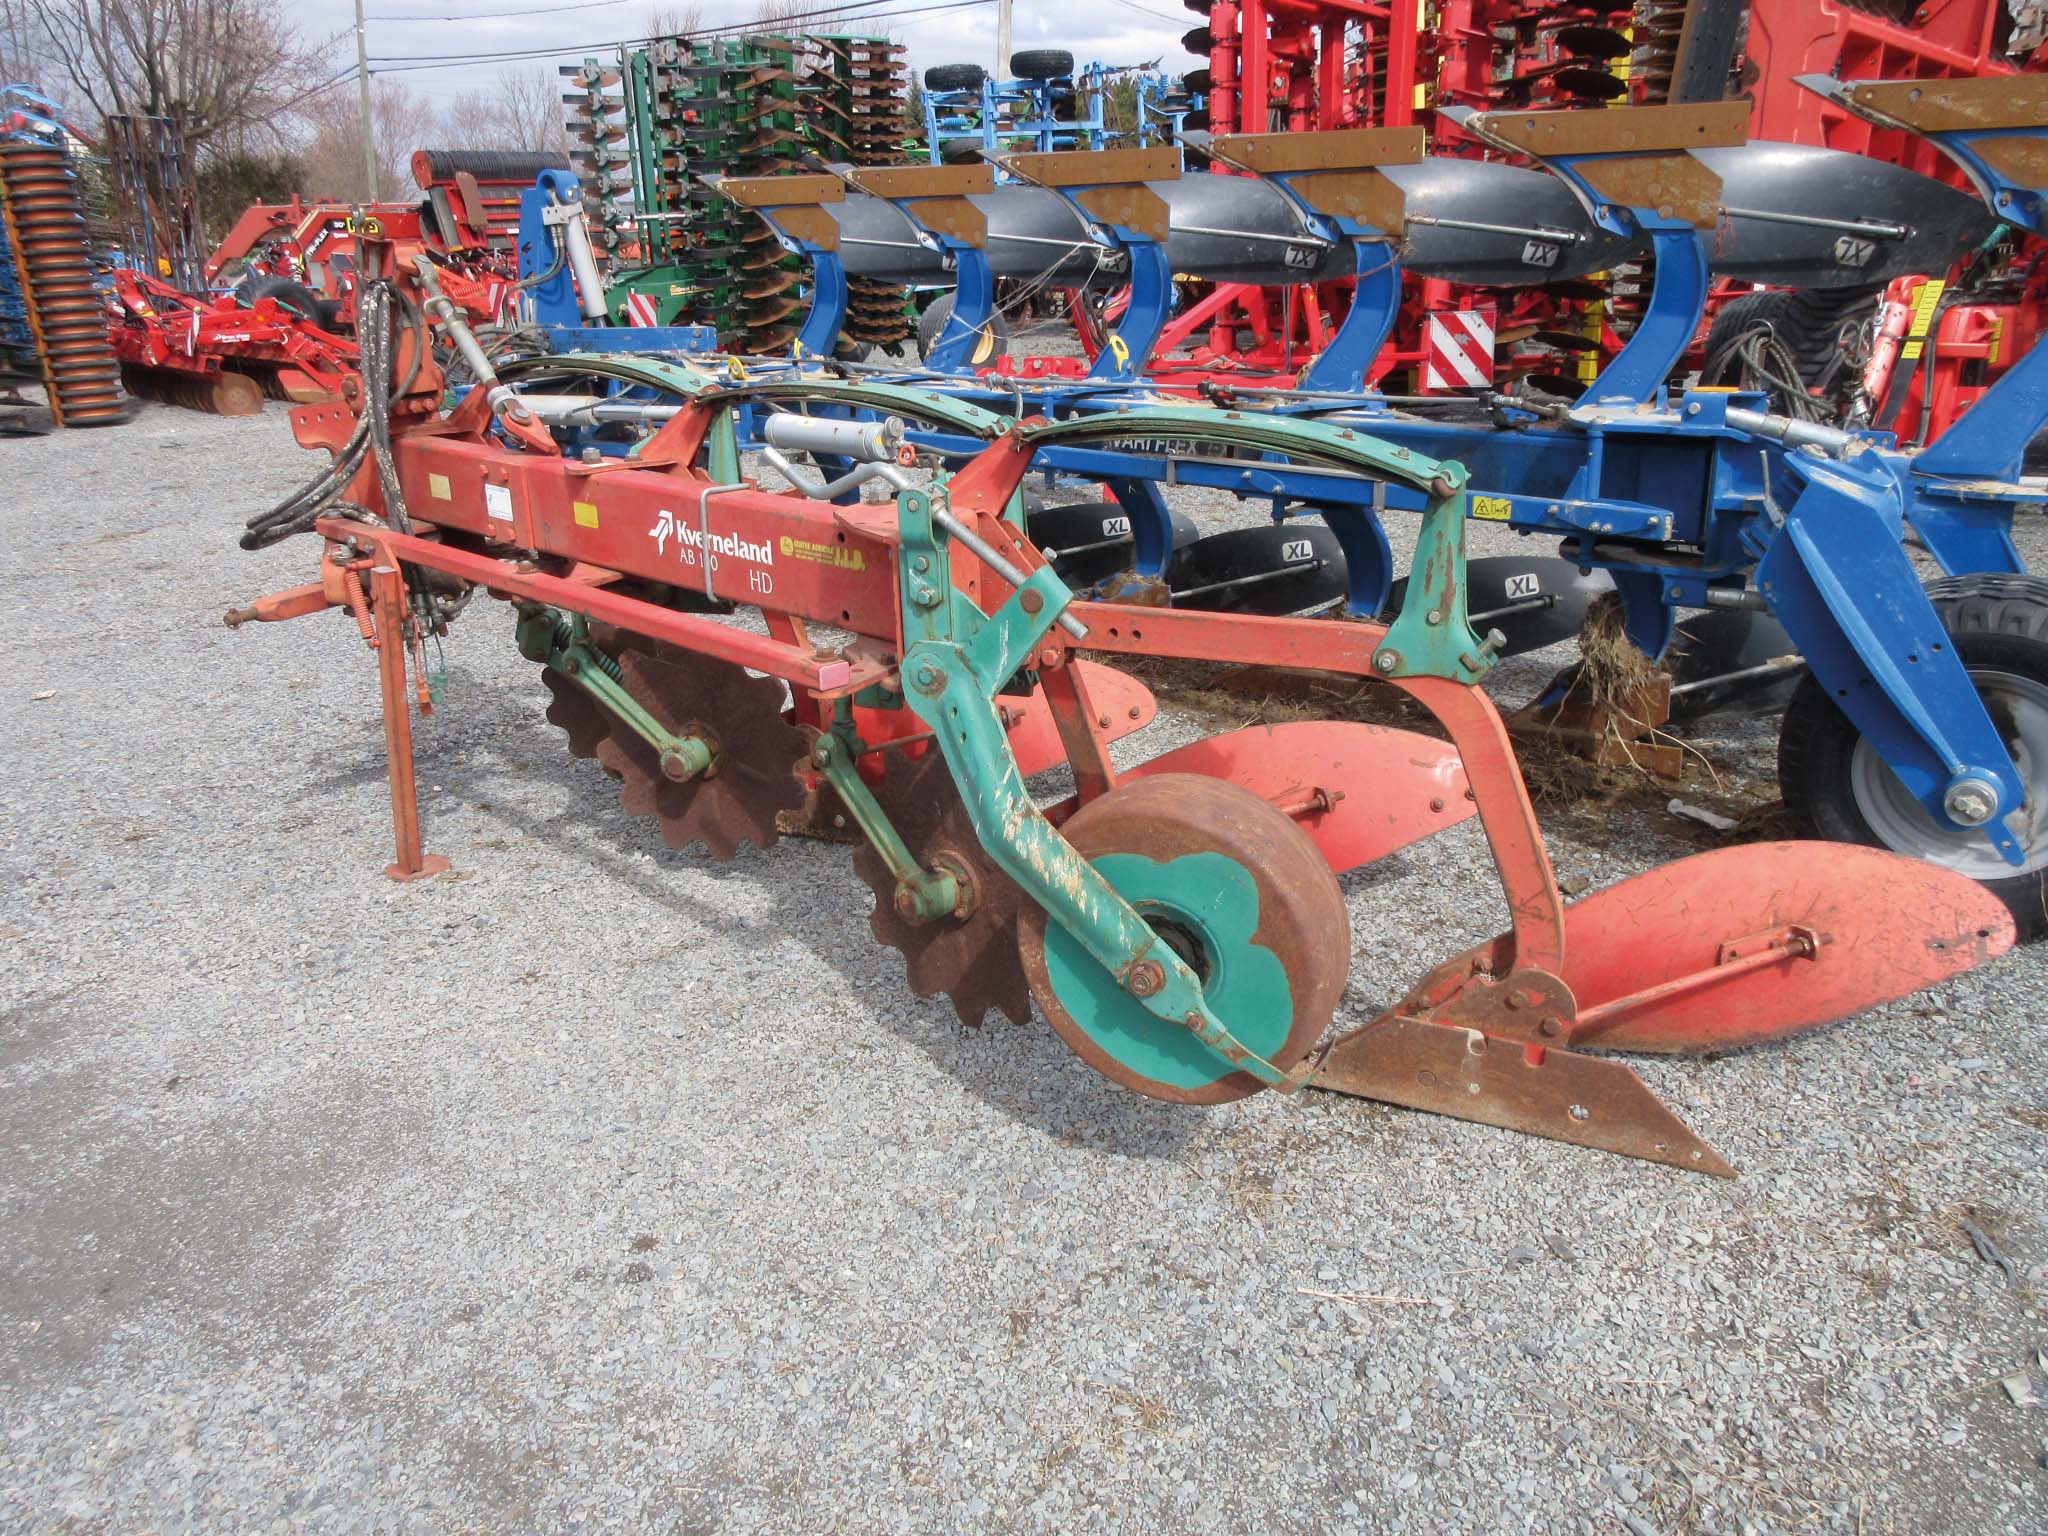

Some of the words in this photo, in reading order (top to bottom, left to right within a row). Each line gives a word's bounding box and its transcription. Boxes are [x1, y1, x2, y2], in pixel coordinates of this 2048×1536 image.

[1107, 519, 1130, 534] XL
[676, 519, 773, 566] Kverneland
[1287, 543, 1311, 560] XL
[680, 547, 696, 565] AB
[699, 552, 719, 571] 10
[749, 568, 773, 595] HD
[1511, 576, 1537, 597] XL
